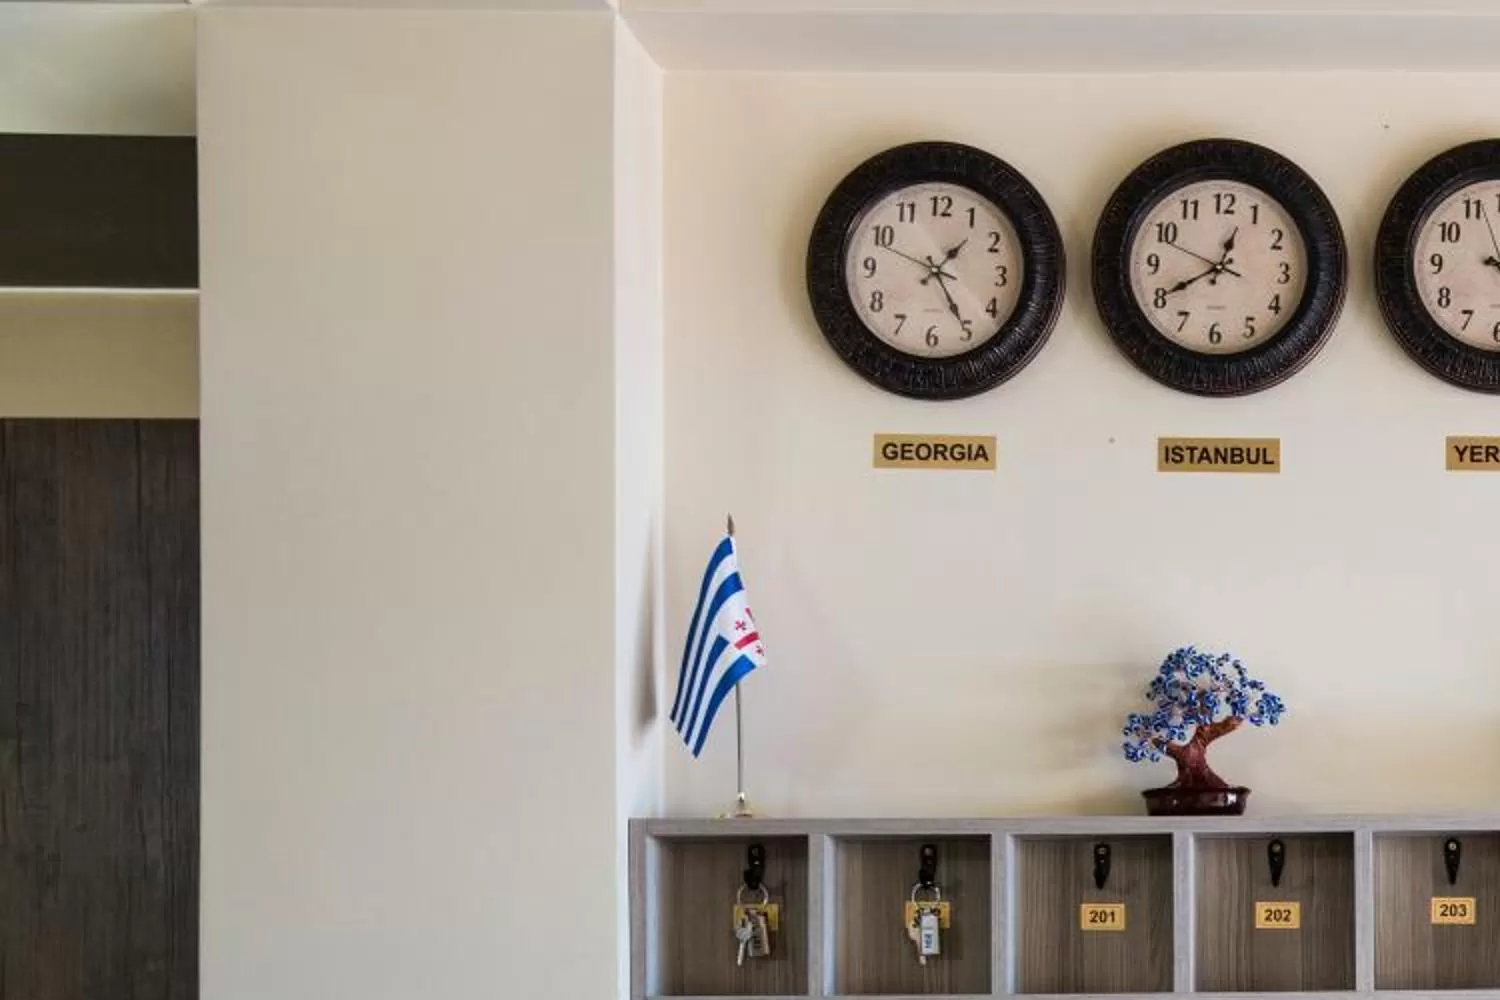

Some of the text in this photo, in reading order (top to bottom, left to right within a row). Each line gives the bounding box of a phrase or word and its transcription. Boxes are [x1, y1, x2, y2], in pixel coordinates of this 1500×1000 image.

[896, 202, 915, 223] 11
[929, 195, 953, 217] 12
[1180, 199, 1199, 221] 11
[1213, 192, 1235, 215] 12
[1250, 204, 1258, 225] 1
[1461, 198, 1481, 220] 11
[966, 207, 975, 229] 1
[872, 225, 895, 247] 10
[987, 231, 1000, 253] 2
[1155, 221, 1177, 243] 10
[1270, 228, 1283, 250] 2
[1439, 221, 1461, 243] 10
[863, 256, 877, 278] 9
[1146, 253, 1160, 275] 9
[1277, 262, 1290, 284] 3
[1430, 253, 1443, 274] 9
[994, 265, 1007, 287] 3
[869, 291, 883, 313] 8
[985, 296, 997, 319] 4
[1153, 287, 1167, 309] 8
[1268, 294, 1281, 315] 4
[1437, 287, 1451, 308] 8
[894, 313, 907, 336] 7
[960, 319, 973, 342] 5
[1177, 311, 1190, 333] 7
[1242, 317, 1255, 339] 5
[1461, 309, 1474, 331] 7
[925, 325, 939, 347] 6
[1209, 322, 1222, 345] 6
[881, 442, 990, 462] GEORGIA
[1164, 445, 1275, 466] ISTANBUL
[1089, 909, 1117, 924] 201
[1264, 907, 1292, 923] 202
[1439, 903, 1468, 918] 203
